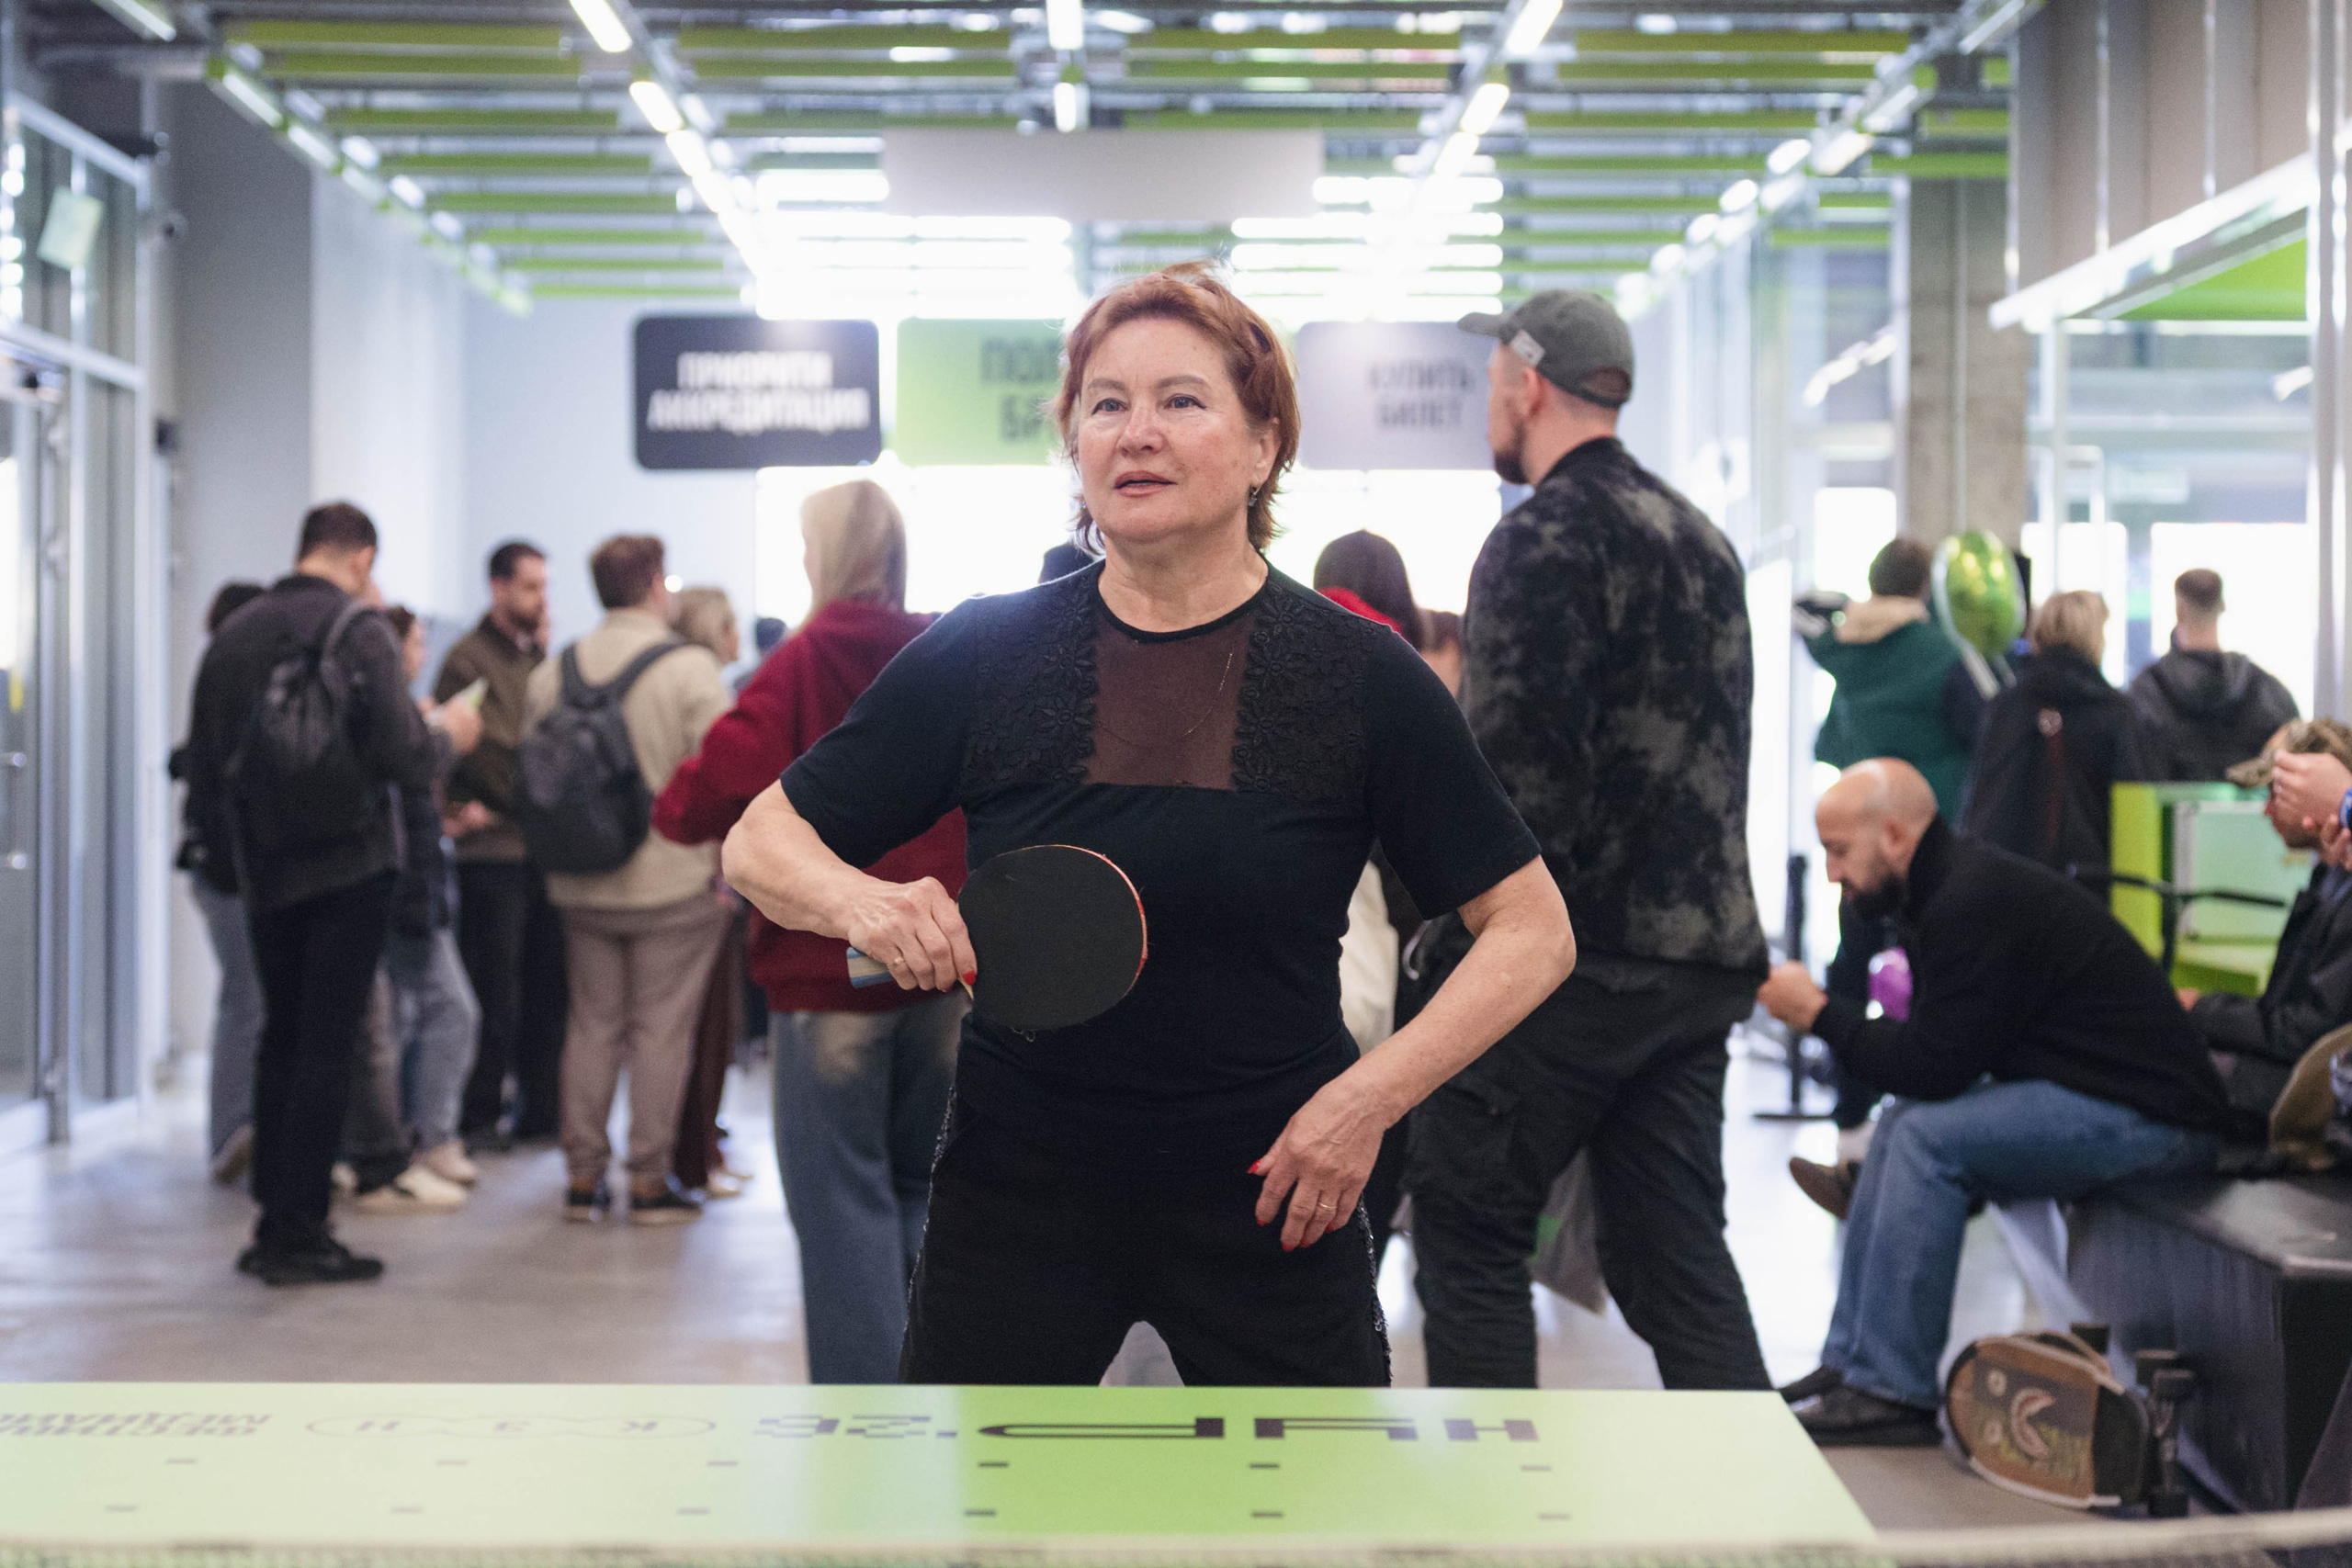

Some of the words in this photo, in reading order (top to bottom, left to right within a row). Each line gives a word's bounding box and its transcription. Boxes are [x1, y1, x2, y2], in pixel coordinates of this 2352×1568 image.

[1366, 362, 1476, 390] КУПИТЬ
[648, 389, 870, 434] АККРЕДИТАЦИЯ
[1376, 399, 1464, 426] БИЛЕТ
